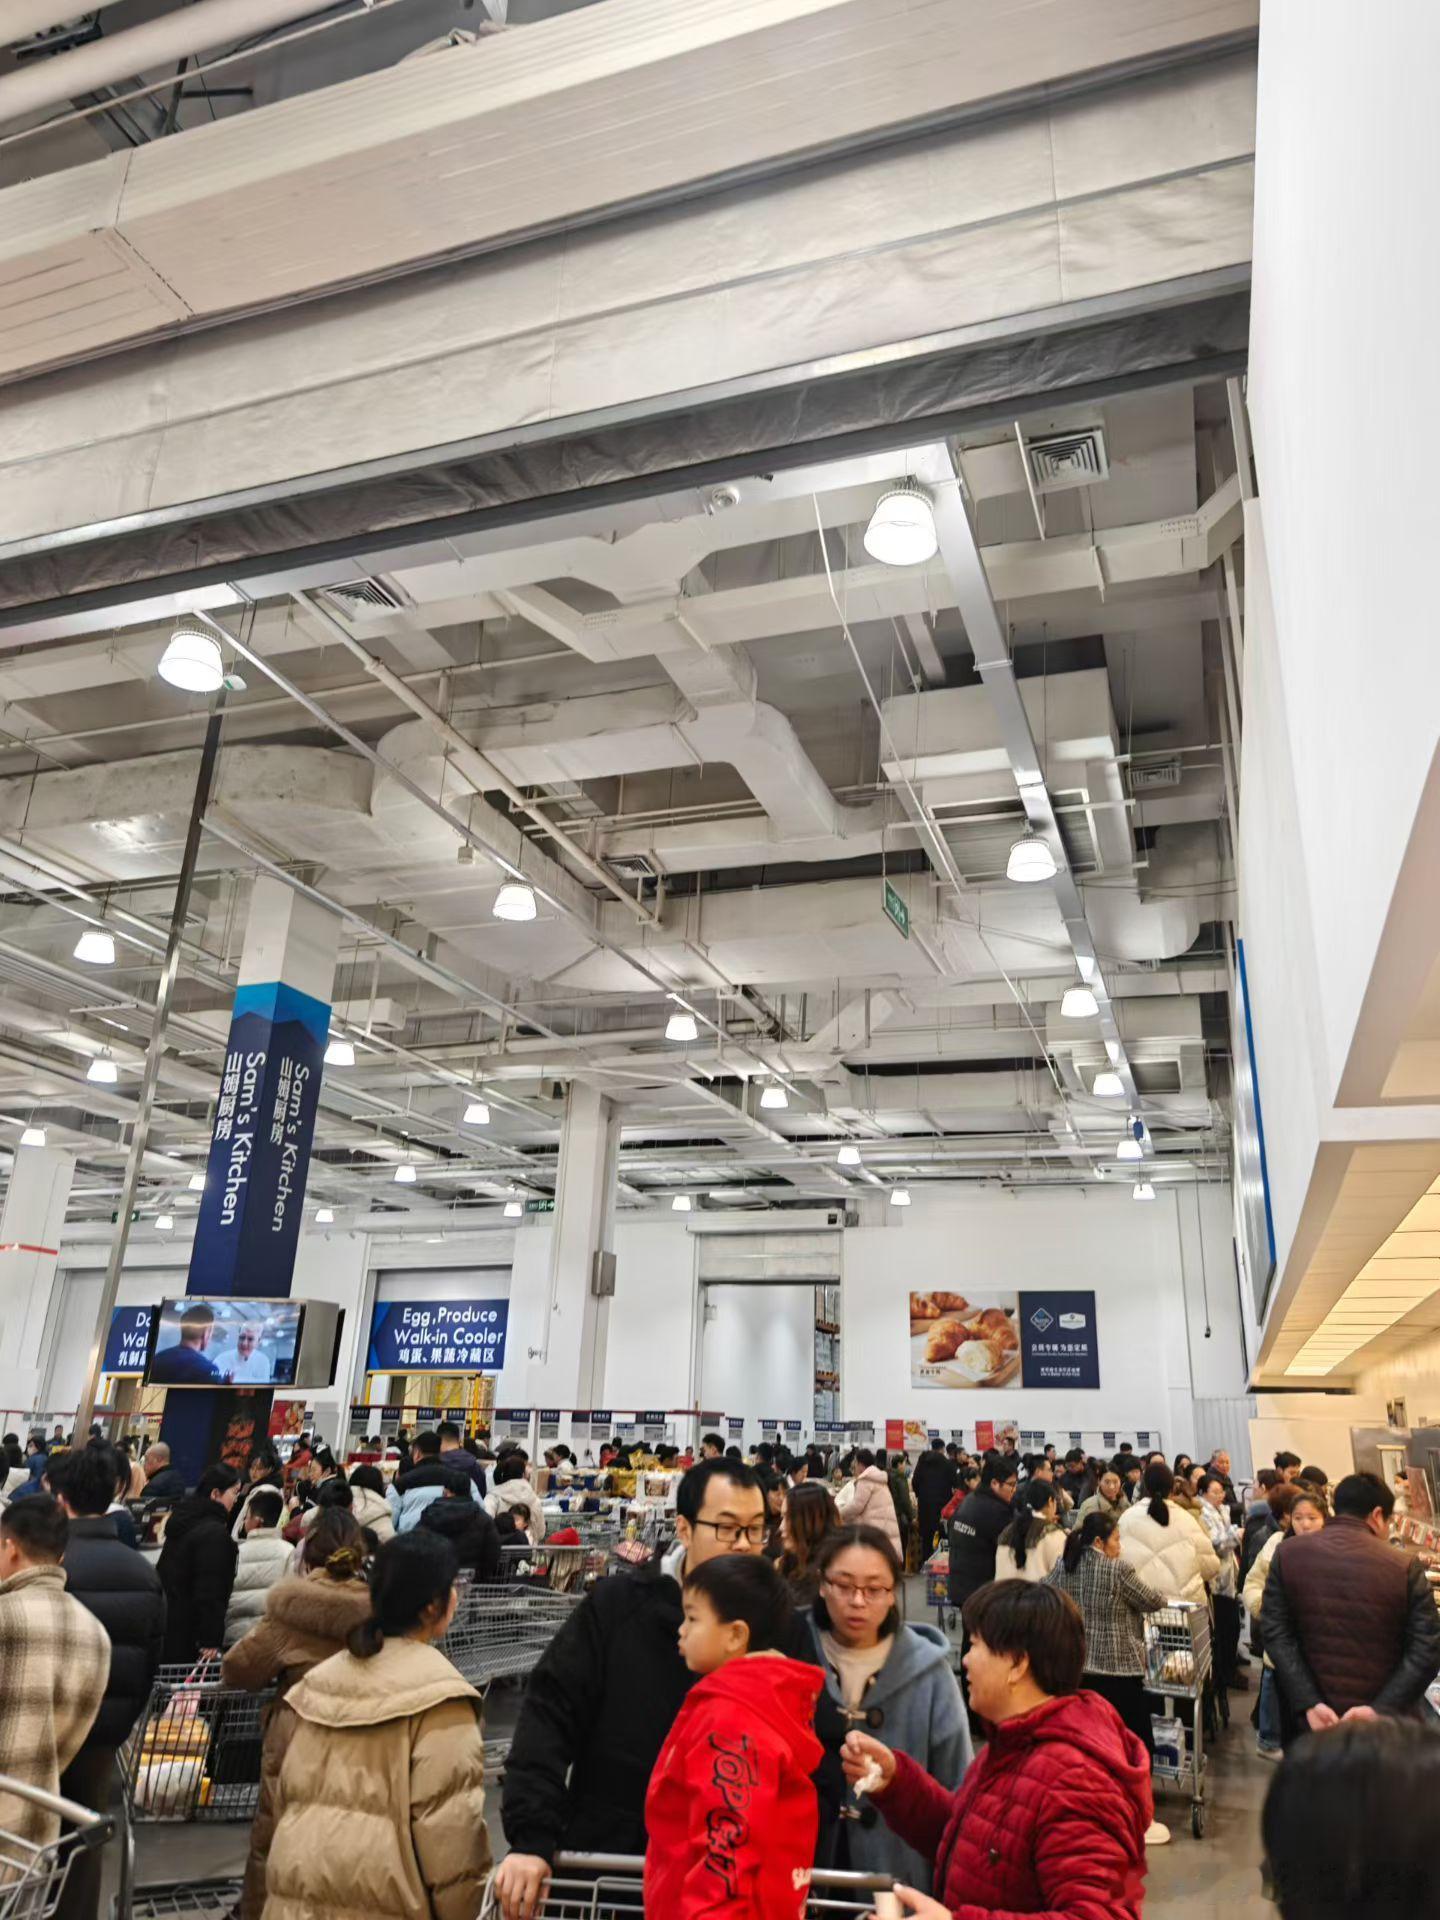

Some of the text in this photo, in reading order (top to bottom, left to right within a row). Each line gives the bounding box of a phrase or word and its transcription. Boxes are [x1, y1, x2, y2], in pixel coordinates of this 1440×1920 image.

[214, 1051, 244, 1141] 山姆厨房
[219, 1051, 266, 1226] Sam's Kitchen
[270, 1055, 294, 1146] 山姆厨房
[271, 1062, 310, 1233] Sam's Kitchen
[394, 1327, 503, 1345] Walk-in Cooler
[398, 1347, 496, 1364] 鸡蛋、果蔬冷藏区
